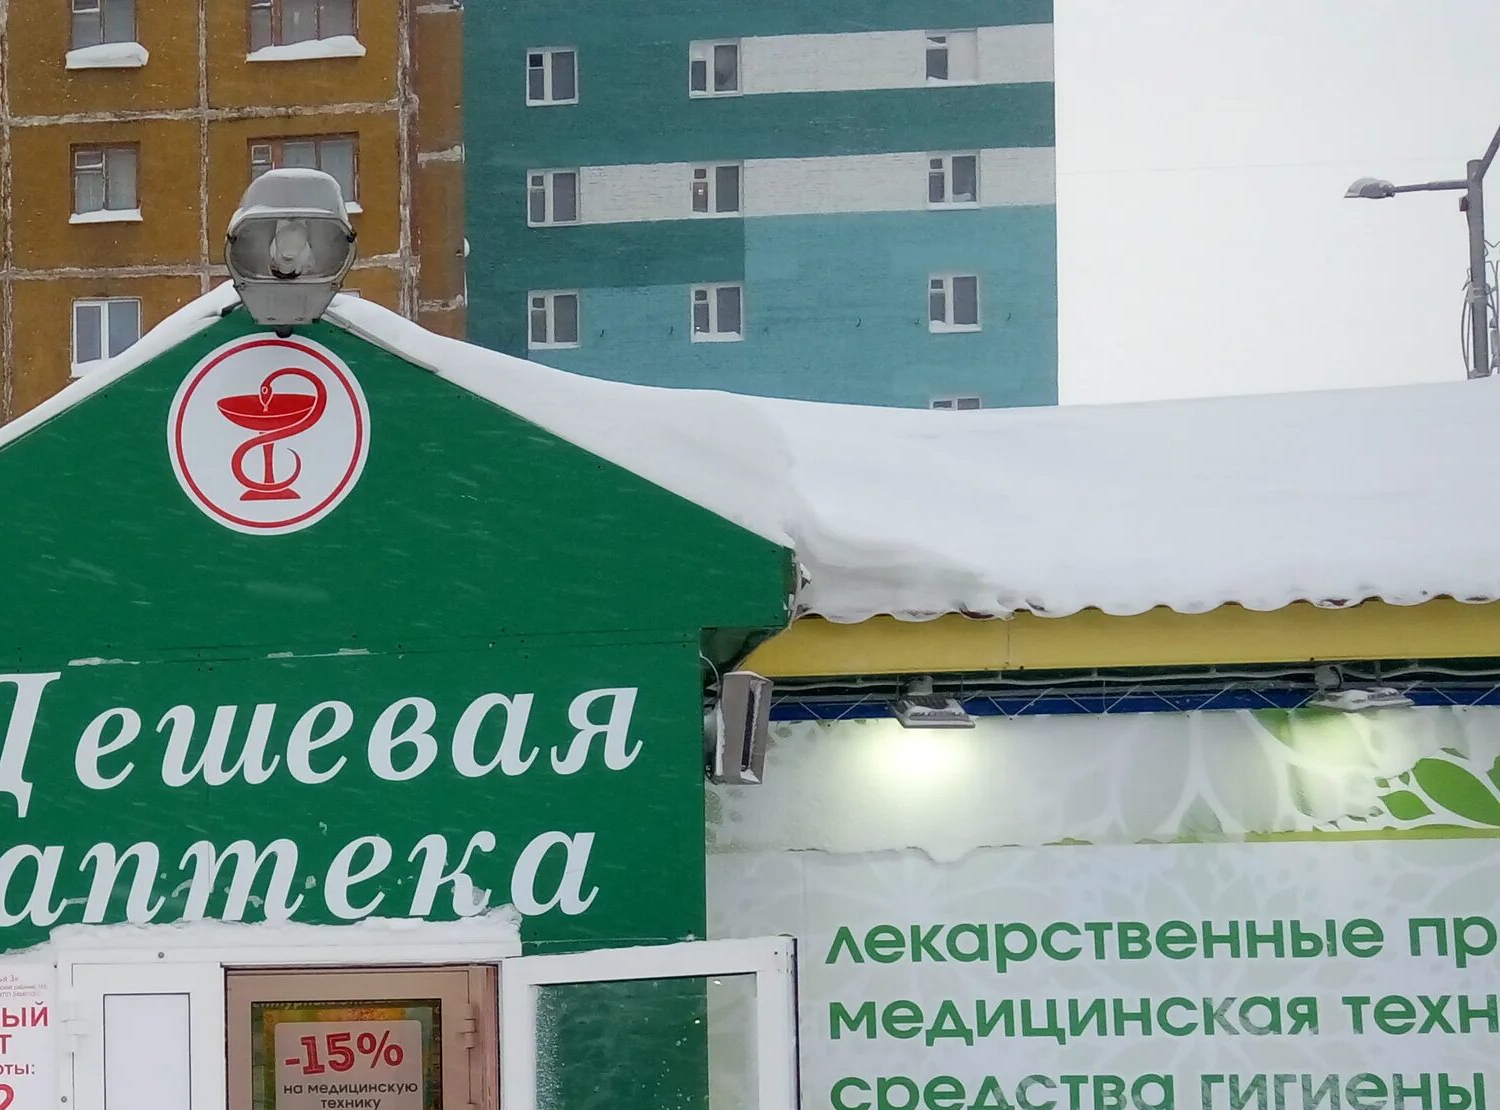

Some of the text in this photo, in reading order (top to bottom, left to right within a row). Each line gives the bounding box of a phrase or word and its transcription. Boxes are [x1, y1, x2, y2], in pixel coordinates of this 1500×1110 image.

[825, 916, 1498, 974] лекарственные пр
[829, 994, 1500, 1047] медицинская техн
[285, 1030, 404, 1075] -15%
[283, 1082, 418, 1095] на медицинскую
[320, 1098, 381, 1110] технику
